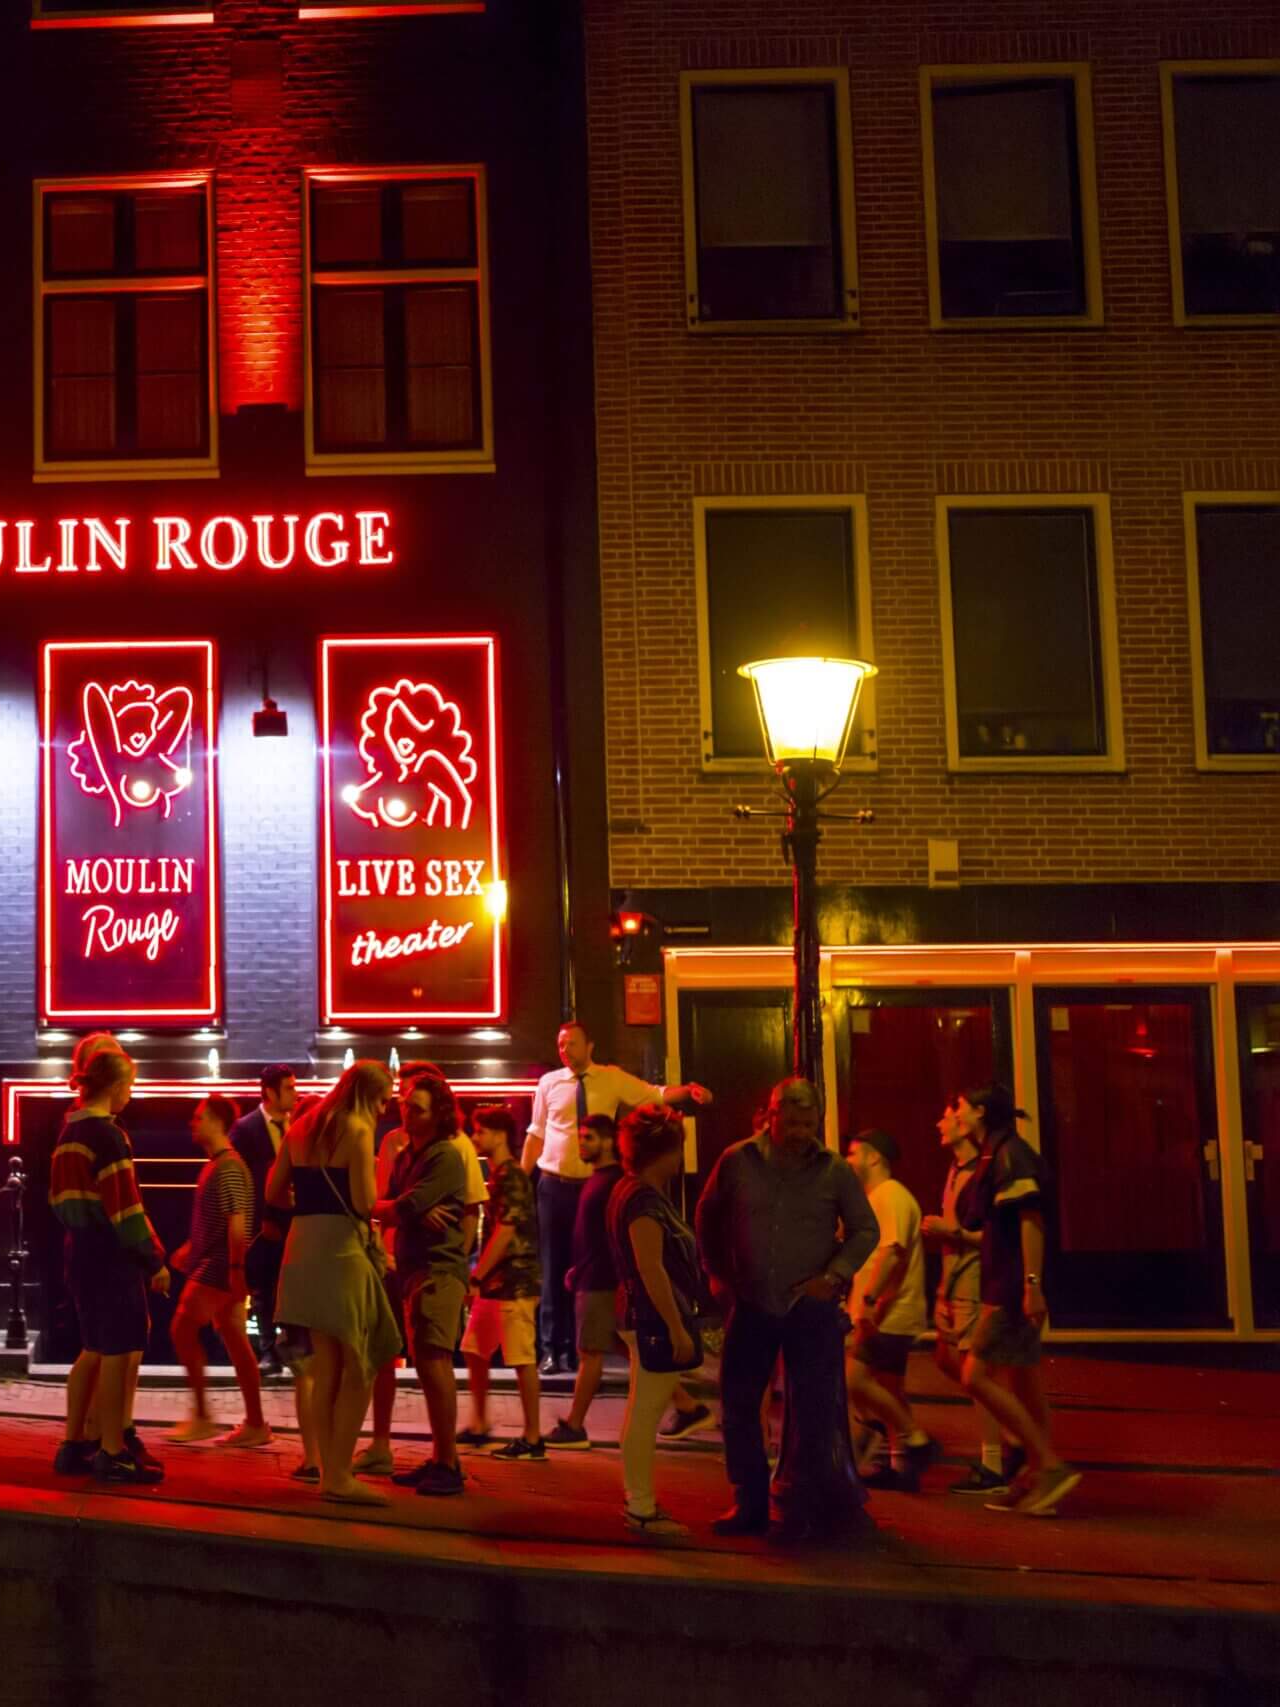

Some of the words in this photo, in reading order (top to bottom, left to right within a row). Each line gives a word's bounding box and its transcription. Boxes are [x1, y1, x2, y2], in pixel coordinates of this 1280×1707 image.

[153, 511, 394, 570] ROUGE
[64, 857, 195, 895] MOULIN
[336, 859, 417, 897] LIVE
[424, 859, 486, 897] SEX
[81, 904, 180, 961] Rouge
[350, 918, 475, 967] theater
